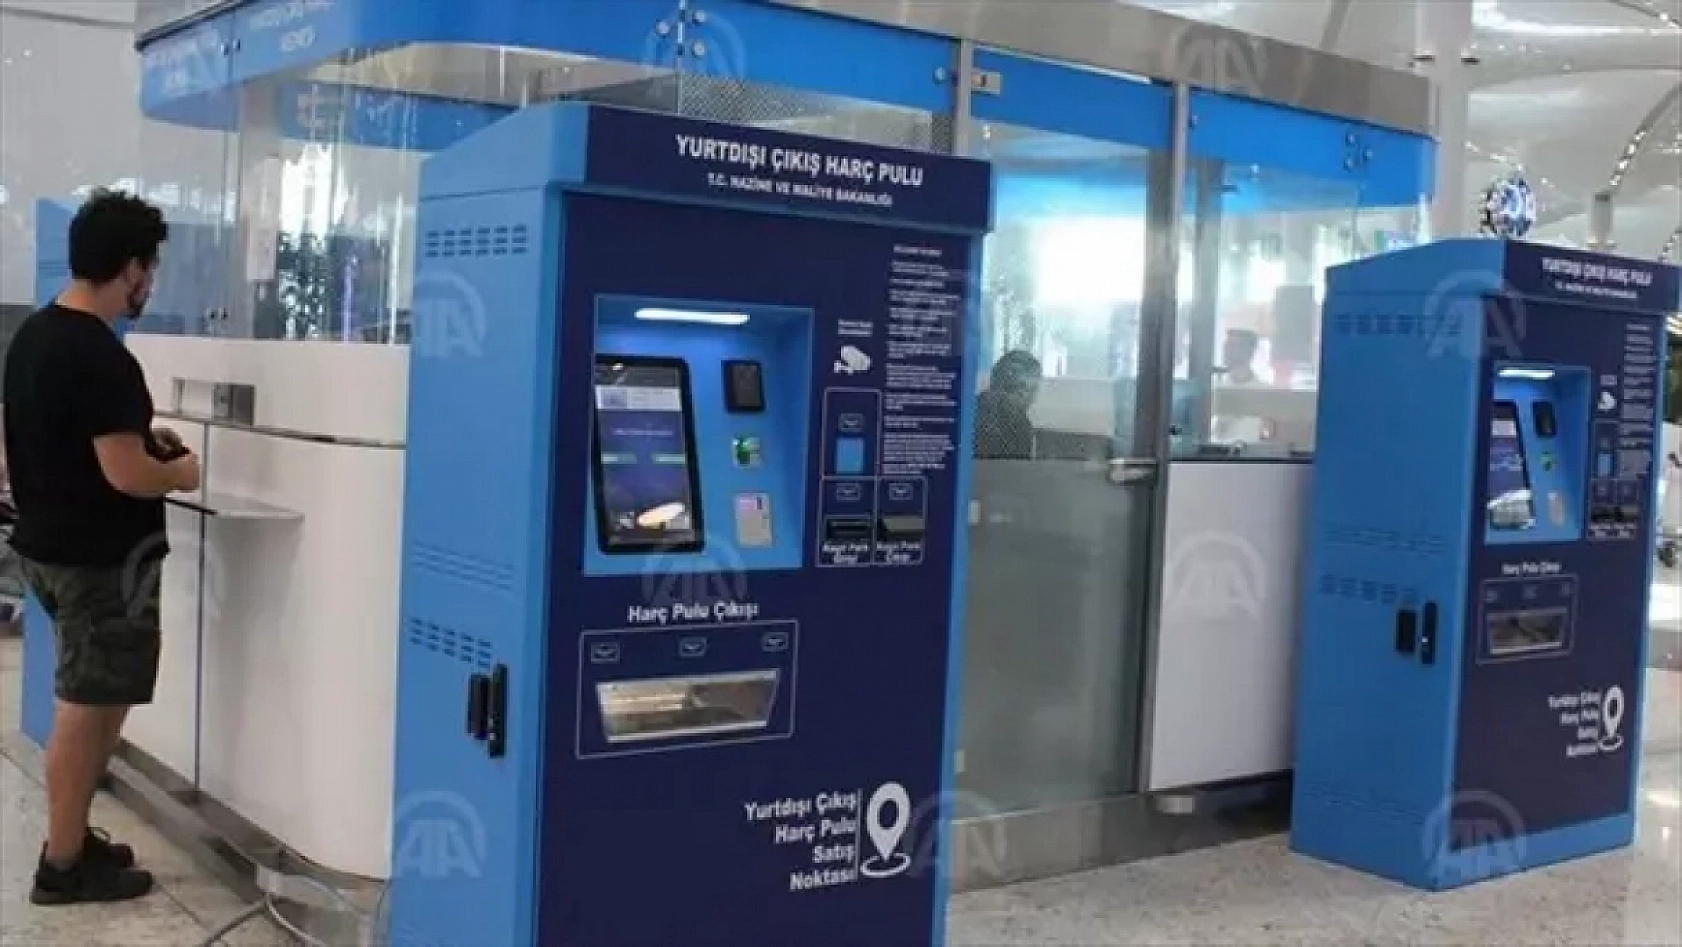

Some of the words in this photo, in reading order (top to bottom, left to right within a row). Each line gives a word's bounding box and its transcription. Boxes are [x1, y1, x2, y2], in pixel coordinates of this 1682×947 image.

[675, 134, 767, 171] YURTDIŞI
[772, 149, 821, 178] ÇIKIŞ
[826, 155, 874, 183] HARÇ
[879, 162, 924, 186] PULU
[628, 605, 669, 625] Harç
[672, 603, 709, 620] Pulu
[744, 798, 812, 821] Yurtdışı
[816, 791, 857, 815] Çıkış
[775, 824, 816, 844] Harç
[821, 817, 856, 837] Pulu
[813, 845, 856, 864] Satış
[790, 867, 857, 891] Noktası
